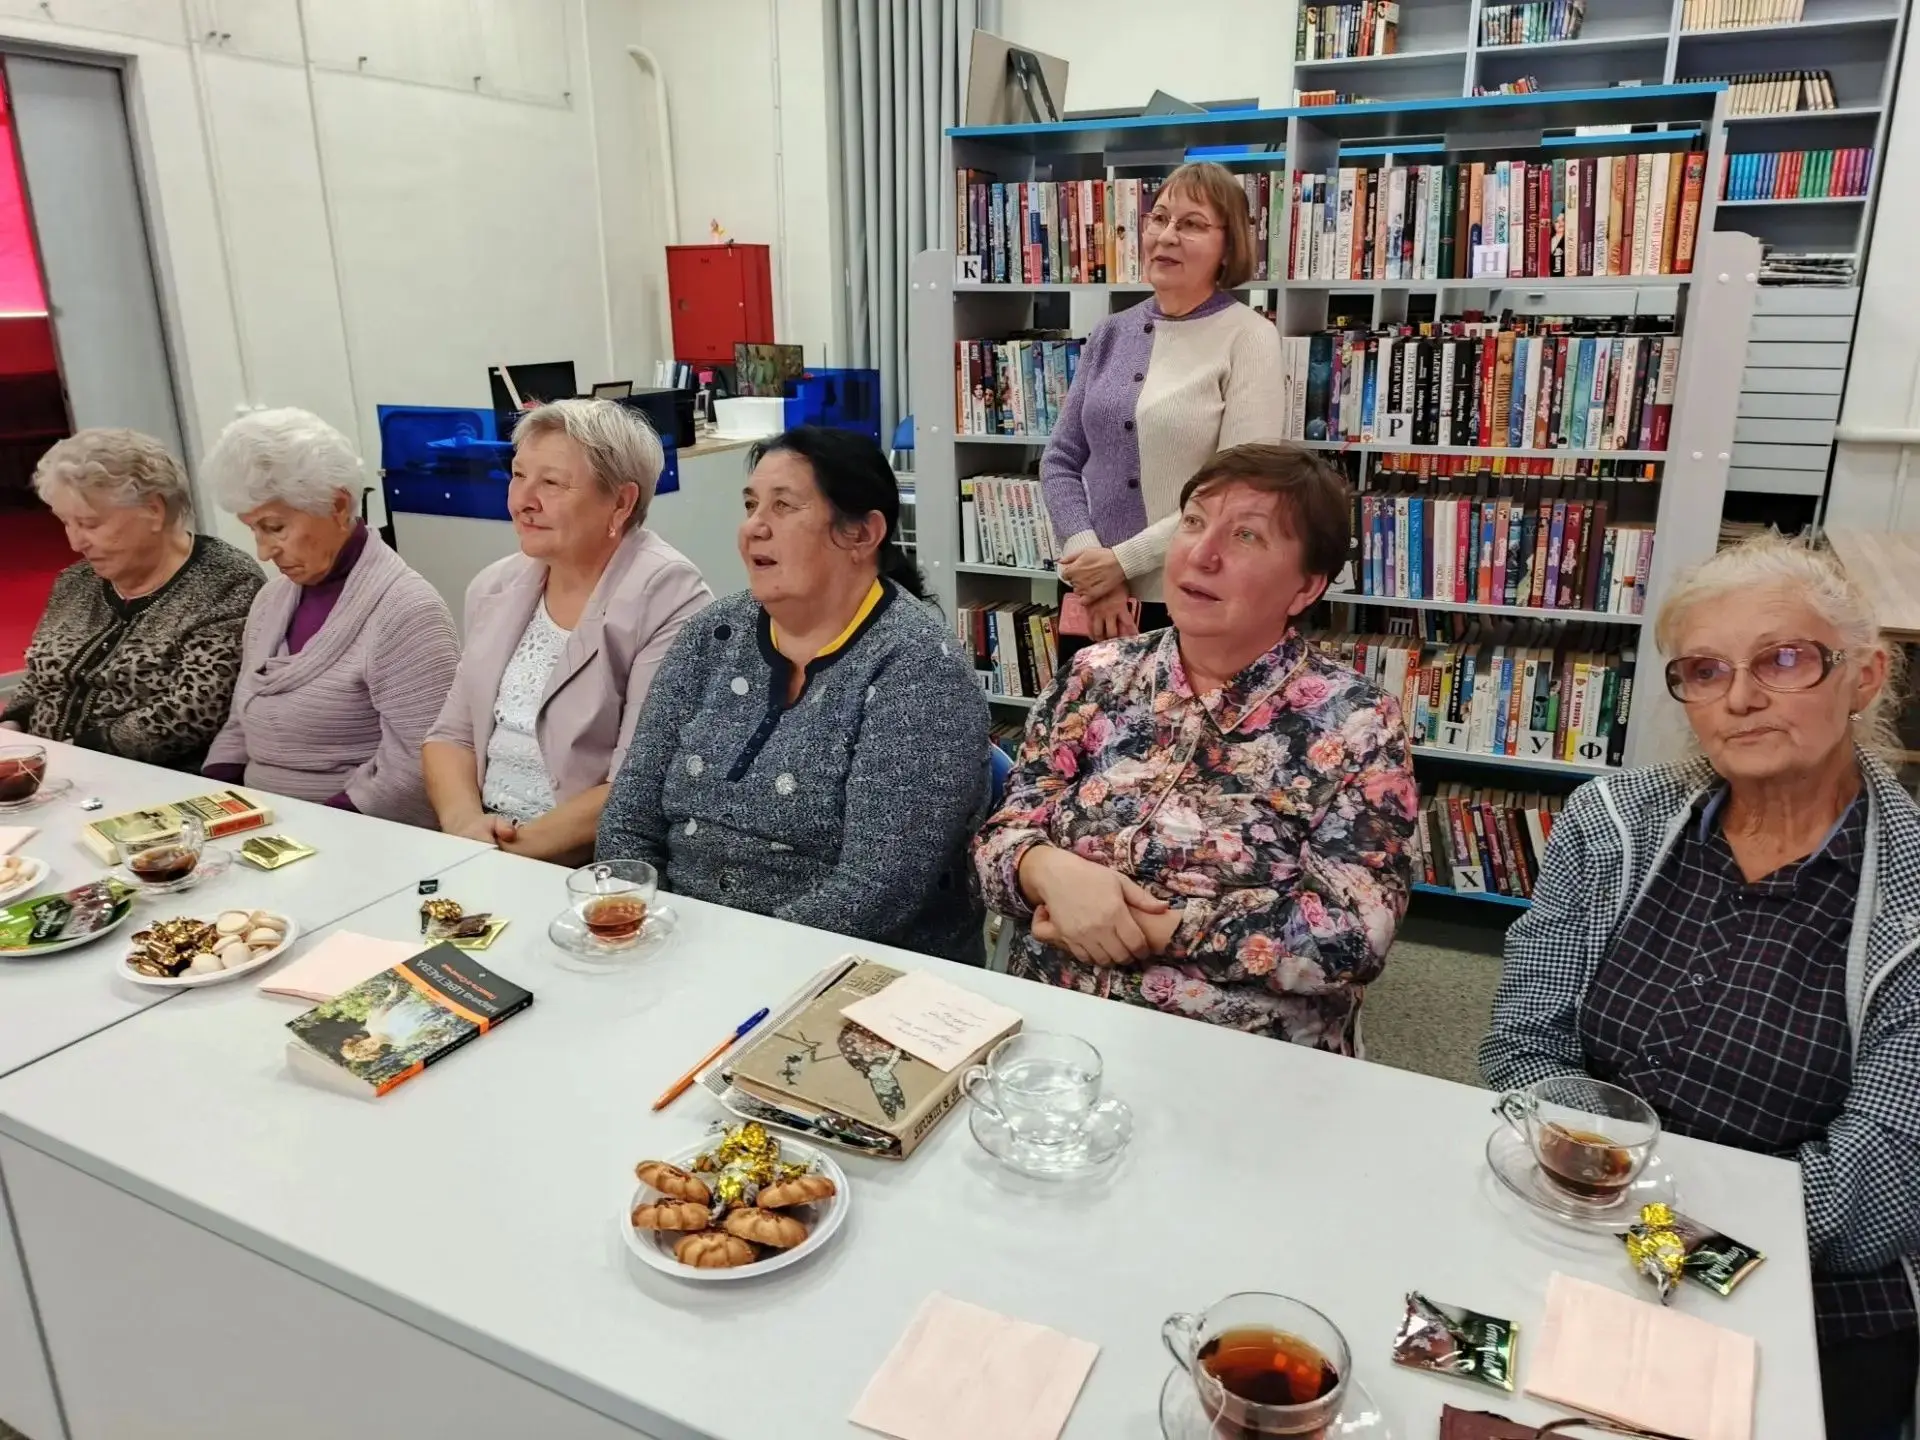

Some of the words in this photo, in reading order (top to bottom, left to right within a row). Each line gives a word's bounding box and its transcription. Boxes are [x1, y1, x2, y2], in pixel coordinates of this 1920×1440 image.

[963, 261, 978, 279] К
[1389, 418, 1404, 437] Р
[1445, 726, 1462, 745] Т
[1531, 736, 1550, 754] У
[1579, 741, 1603, 760] Ф
[416, 959, 465, 996] ЦВЕТАЕВА
